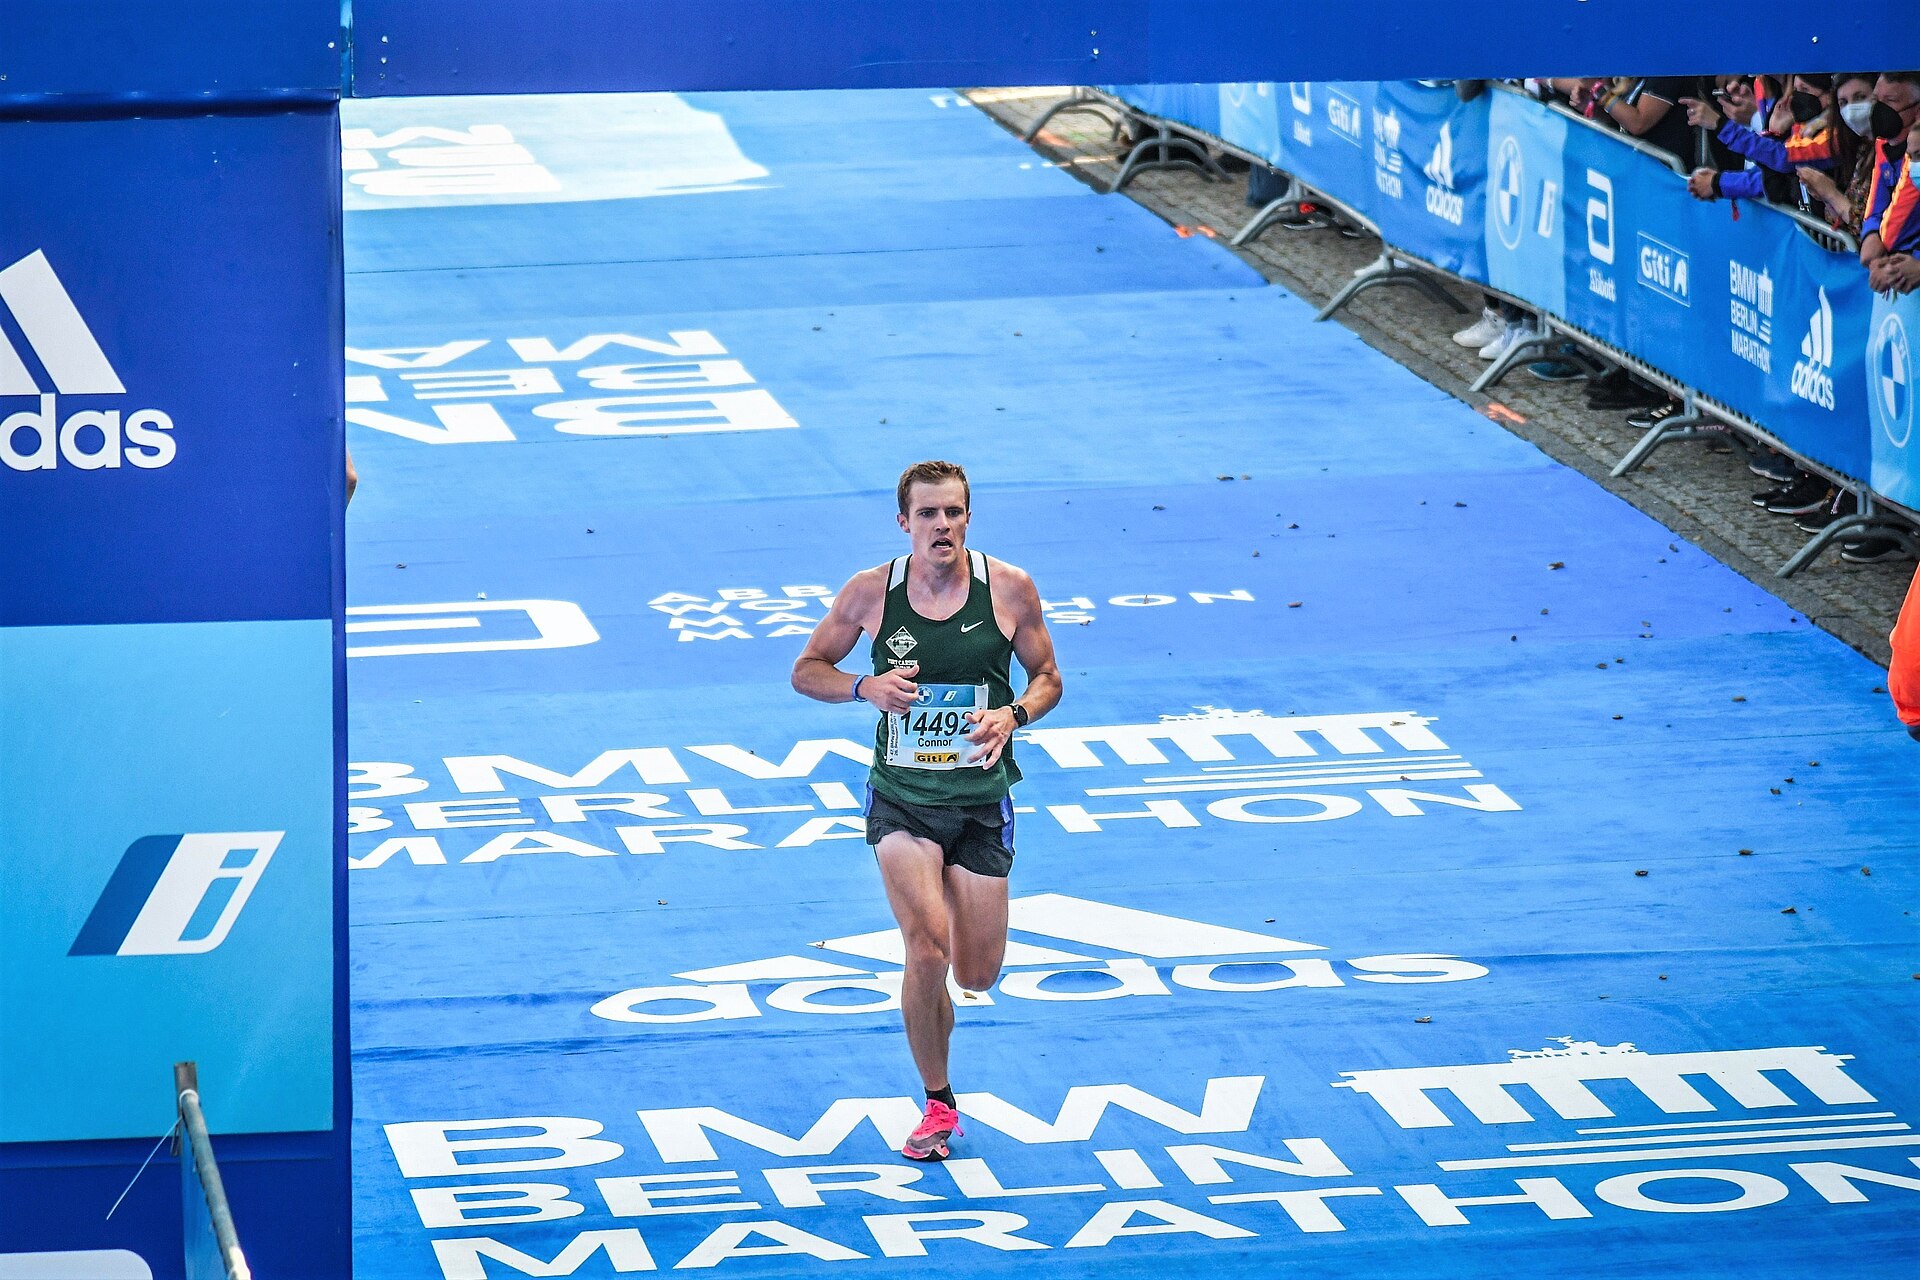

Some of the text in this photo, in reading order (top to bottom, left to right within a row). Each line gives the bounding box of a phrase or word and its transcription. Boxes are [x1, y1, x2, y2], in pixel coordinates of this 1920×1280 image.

[1640, 246, 1671, 289] Giti
[1730, 259, 1758, 305] BMW
[1730, 299, 1758, 336] BERLIN
[1791, 360, 1835, 411] adidas
[900, 710, 975, 737] 14492
[917, 737, 953, 748] Connor
[917, 754, 942, 763] Giti
[384, 1075, 1266, 1178] BMW
[410, 1137, 1353, 1228] BERLIN
[431, 1157, 1920, 1280] MARATHON
